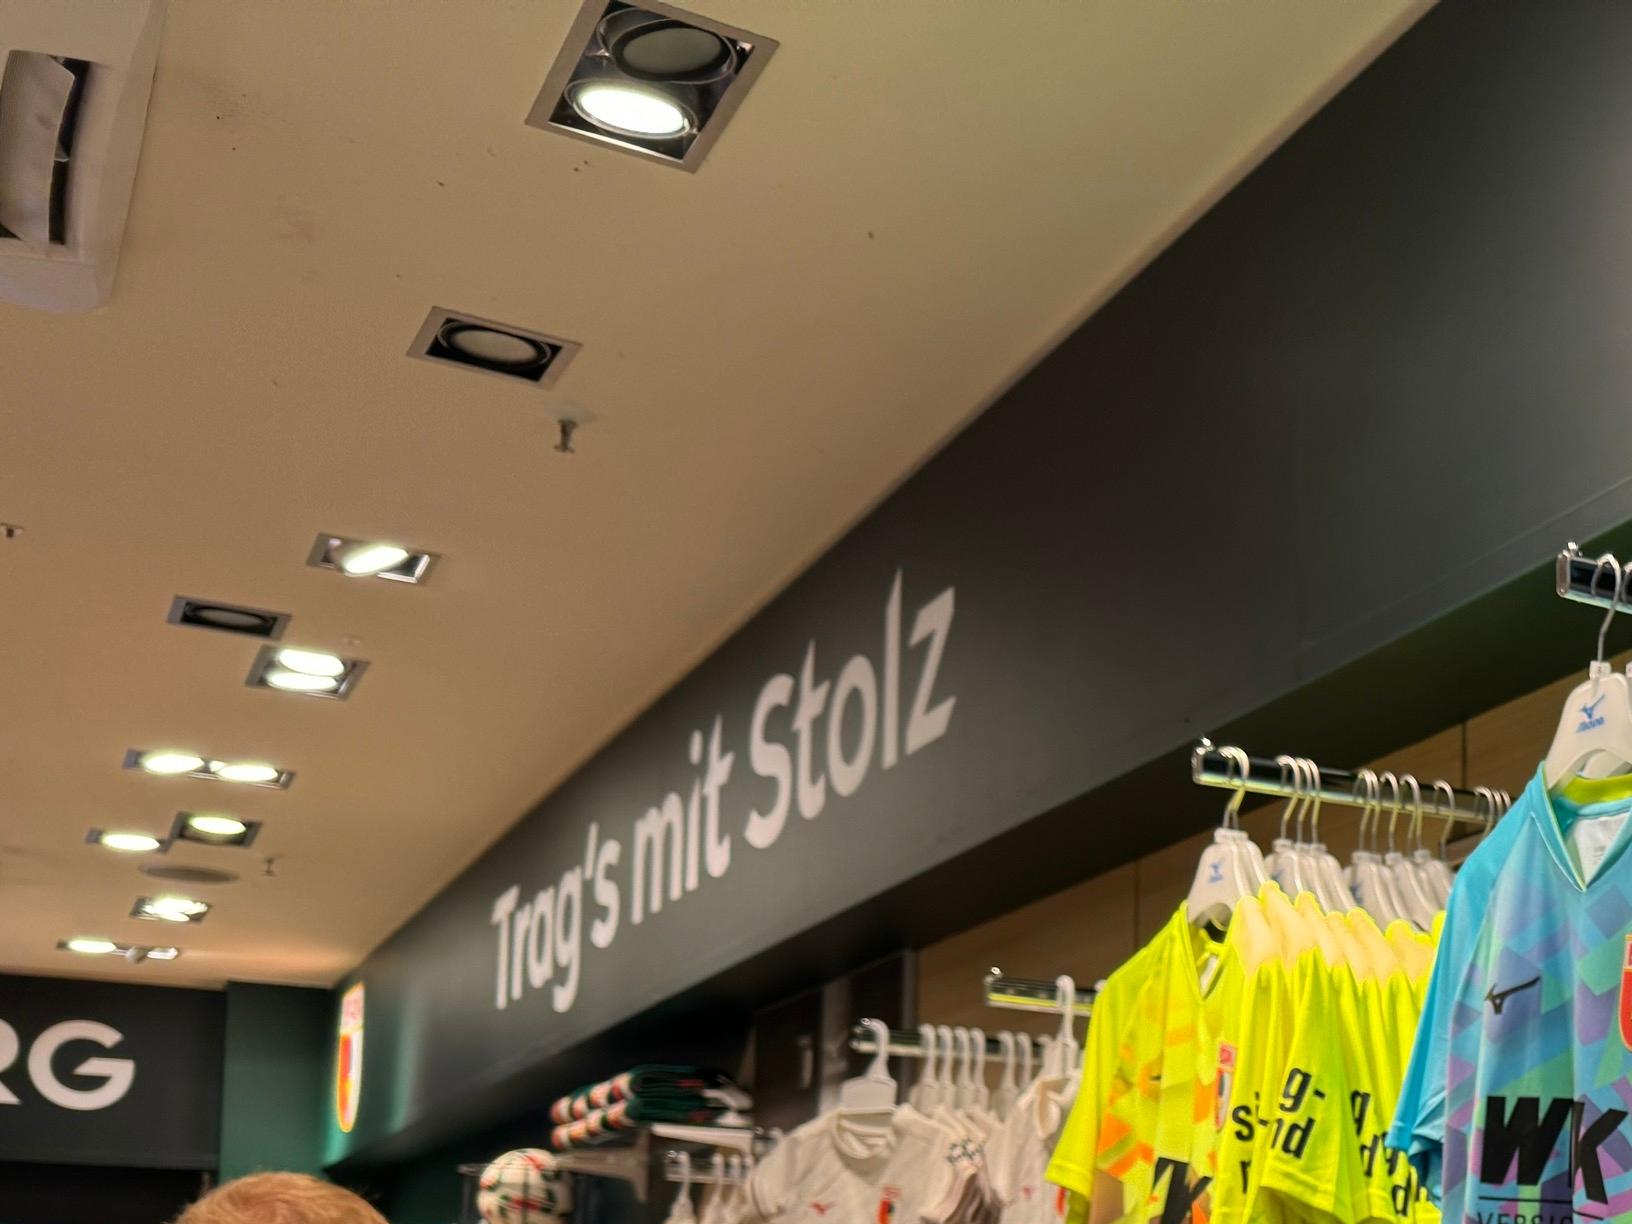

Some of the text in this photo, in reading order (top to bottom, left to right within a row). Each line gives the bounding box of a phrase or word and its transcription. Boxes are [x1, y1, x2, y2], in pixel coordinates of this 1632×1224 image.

[491, 567, 957, 1013] Trag's mit Stolz
